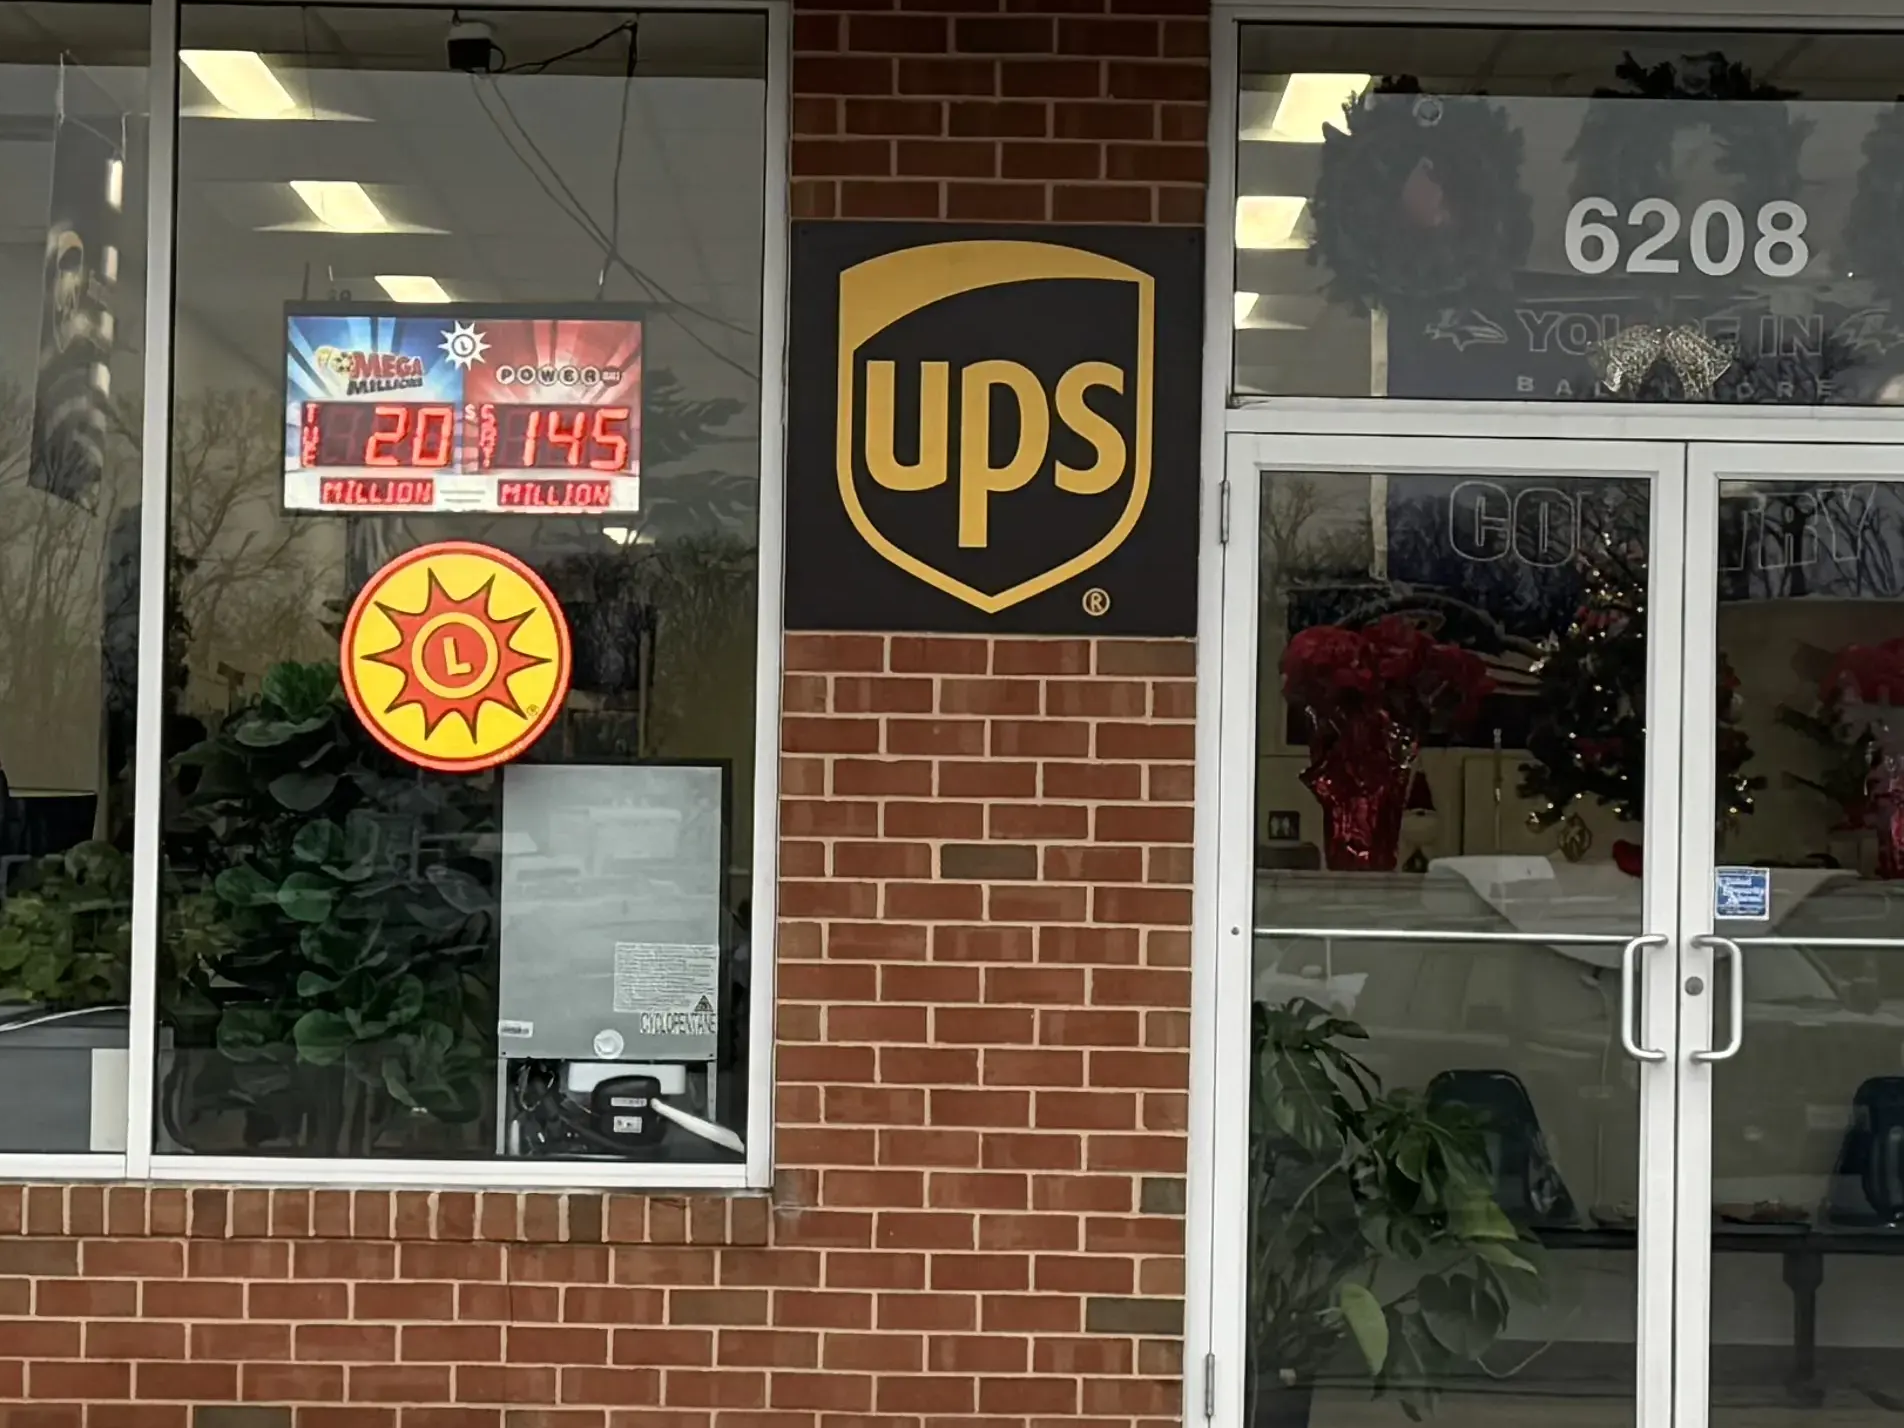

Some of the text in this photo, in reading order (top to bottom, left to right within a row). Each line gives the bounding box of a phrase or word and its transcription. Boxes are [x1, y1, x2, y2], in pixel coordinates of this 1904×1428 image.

[1564, 196, 1809, 277] 6208
[1759, 314, 1823, 358] IN
[351, 350, 423, 378] MEGA
[365, 406, 453, 466] 20
[523, 408, 629, 472] 145
[864, 359, 1127, 548] ups
[322, 479, 433, 504] MILLION
[501, 481, 611, 506] MILLION
